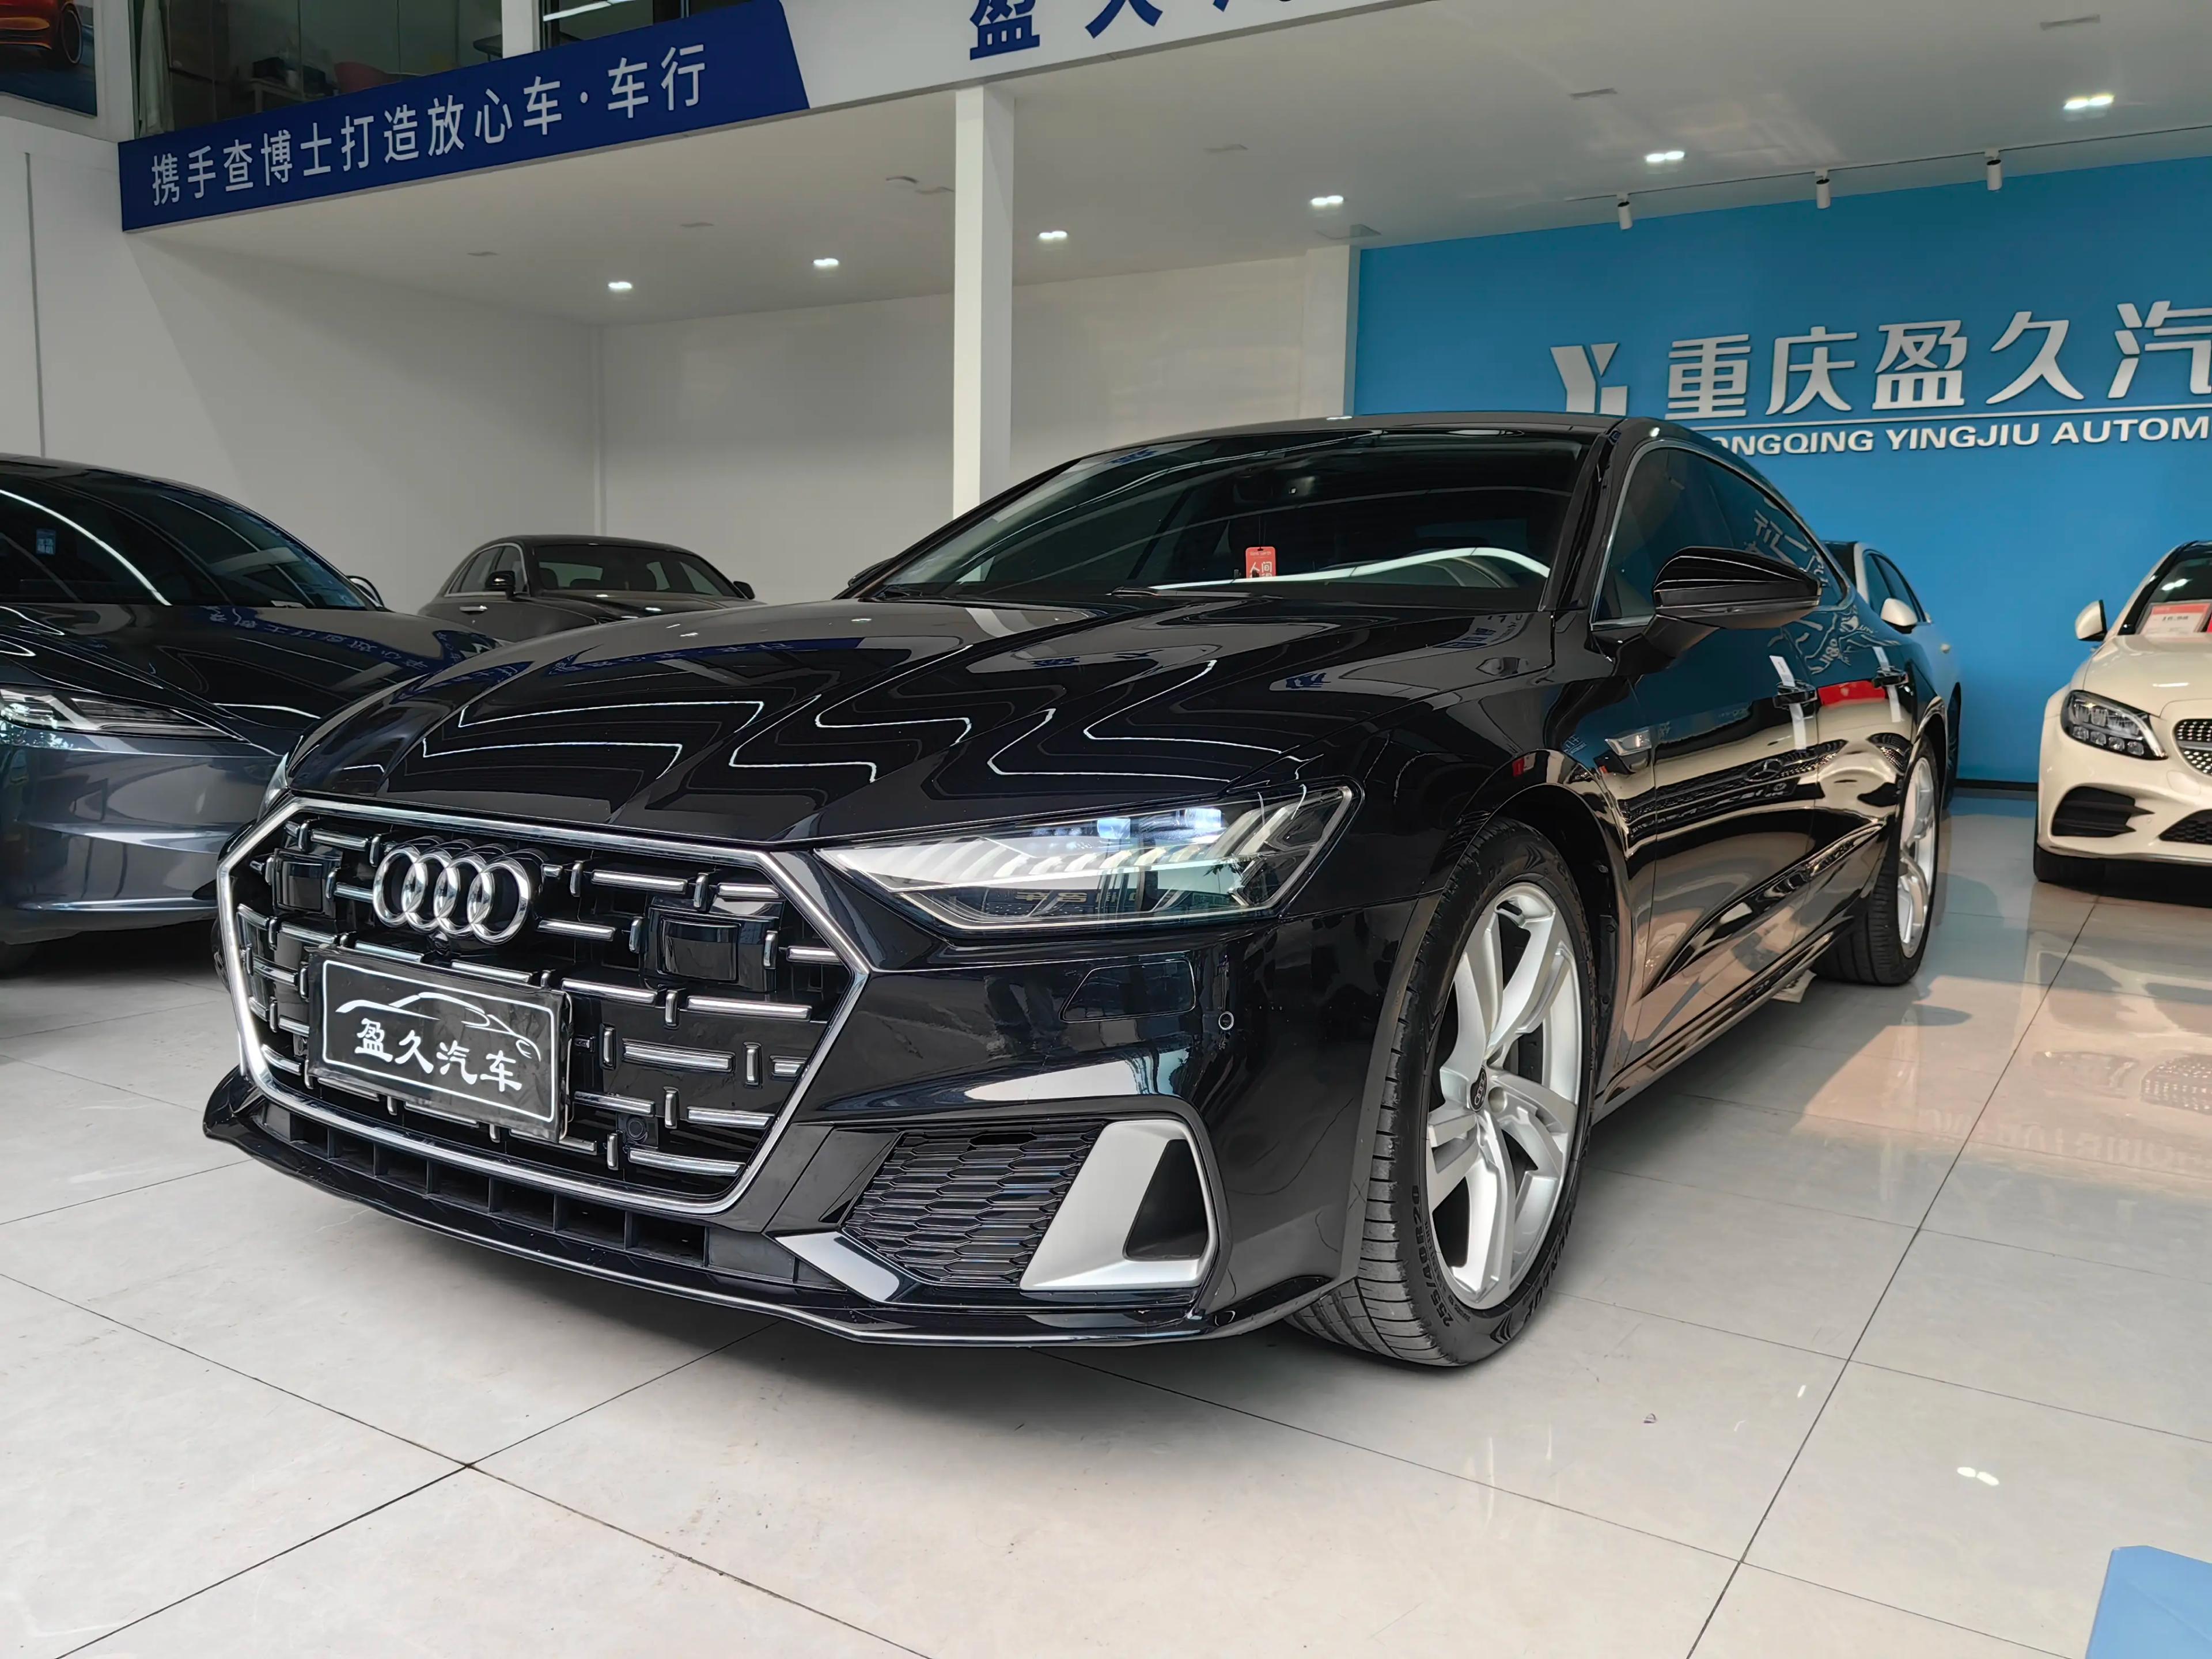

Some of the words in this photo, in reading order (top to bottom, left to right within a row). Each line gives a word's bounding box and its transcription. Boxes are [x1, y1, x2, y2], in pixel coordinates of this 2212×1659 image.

[1665, 300, 2212, 421] 重庆盈久汽
[1885, 422, 2040, 450] YINGJIU
[2051, 416, 2209, 445] AUTOM
[354, 1018, 522, 1092] 盈久汽车
